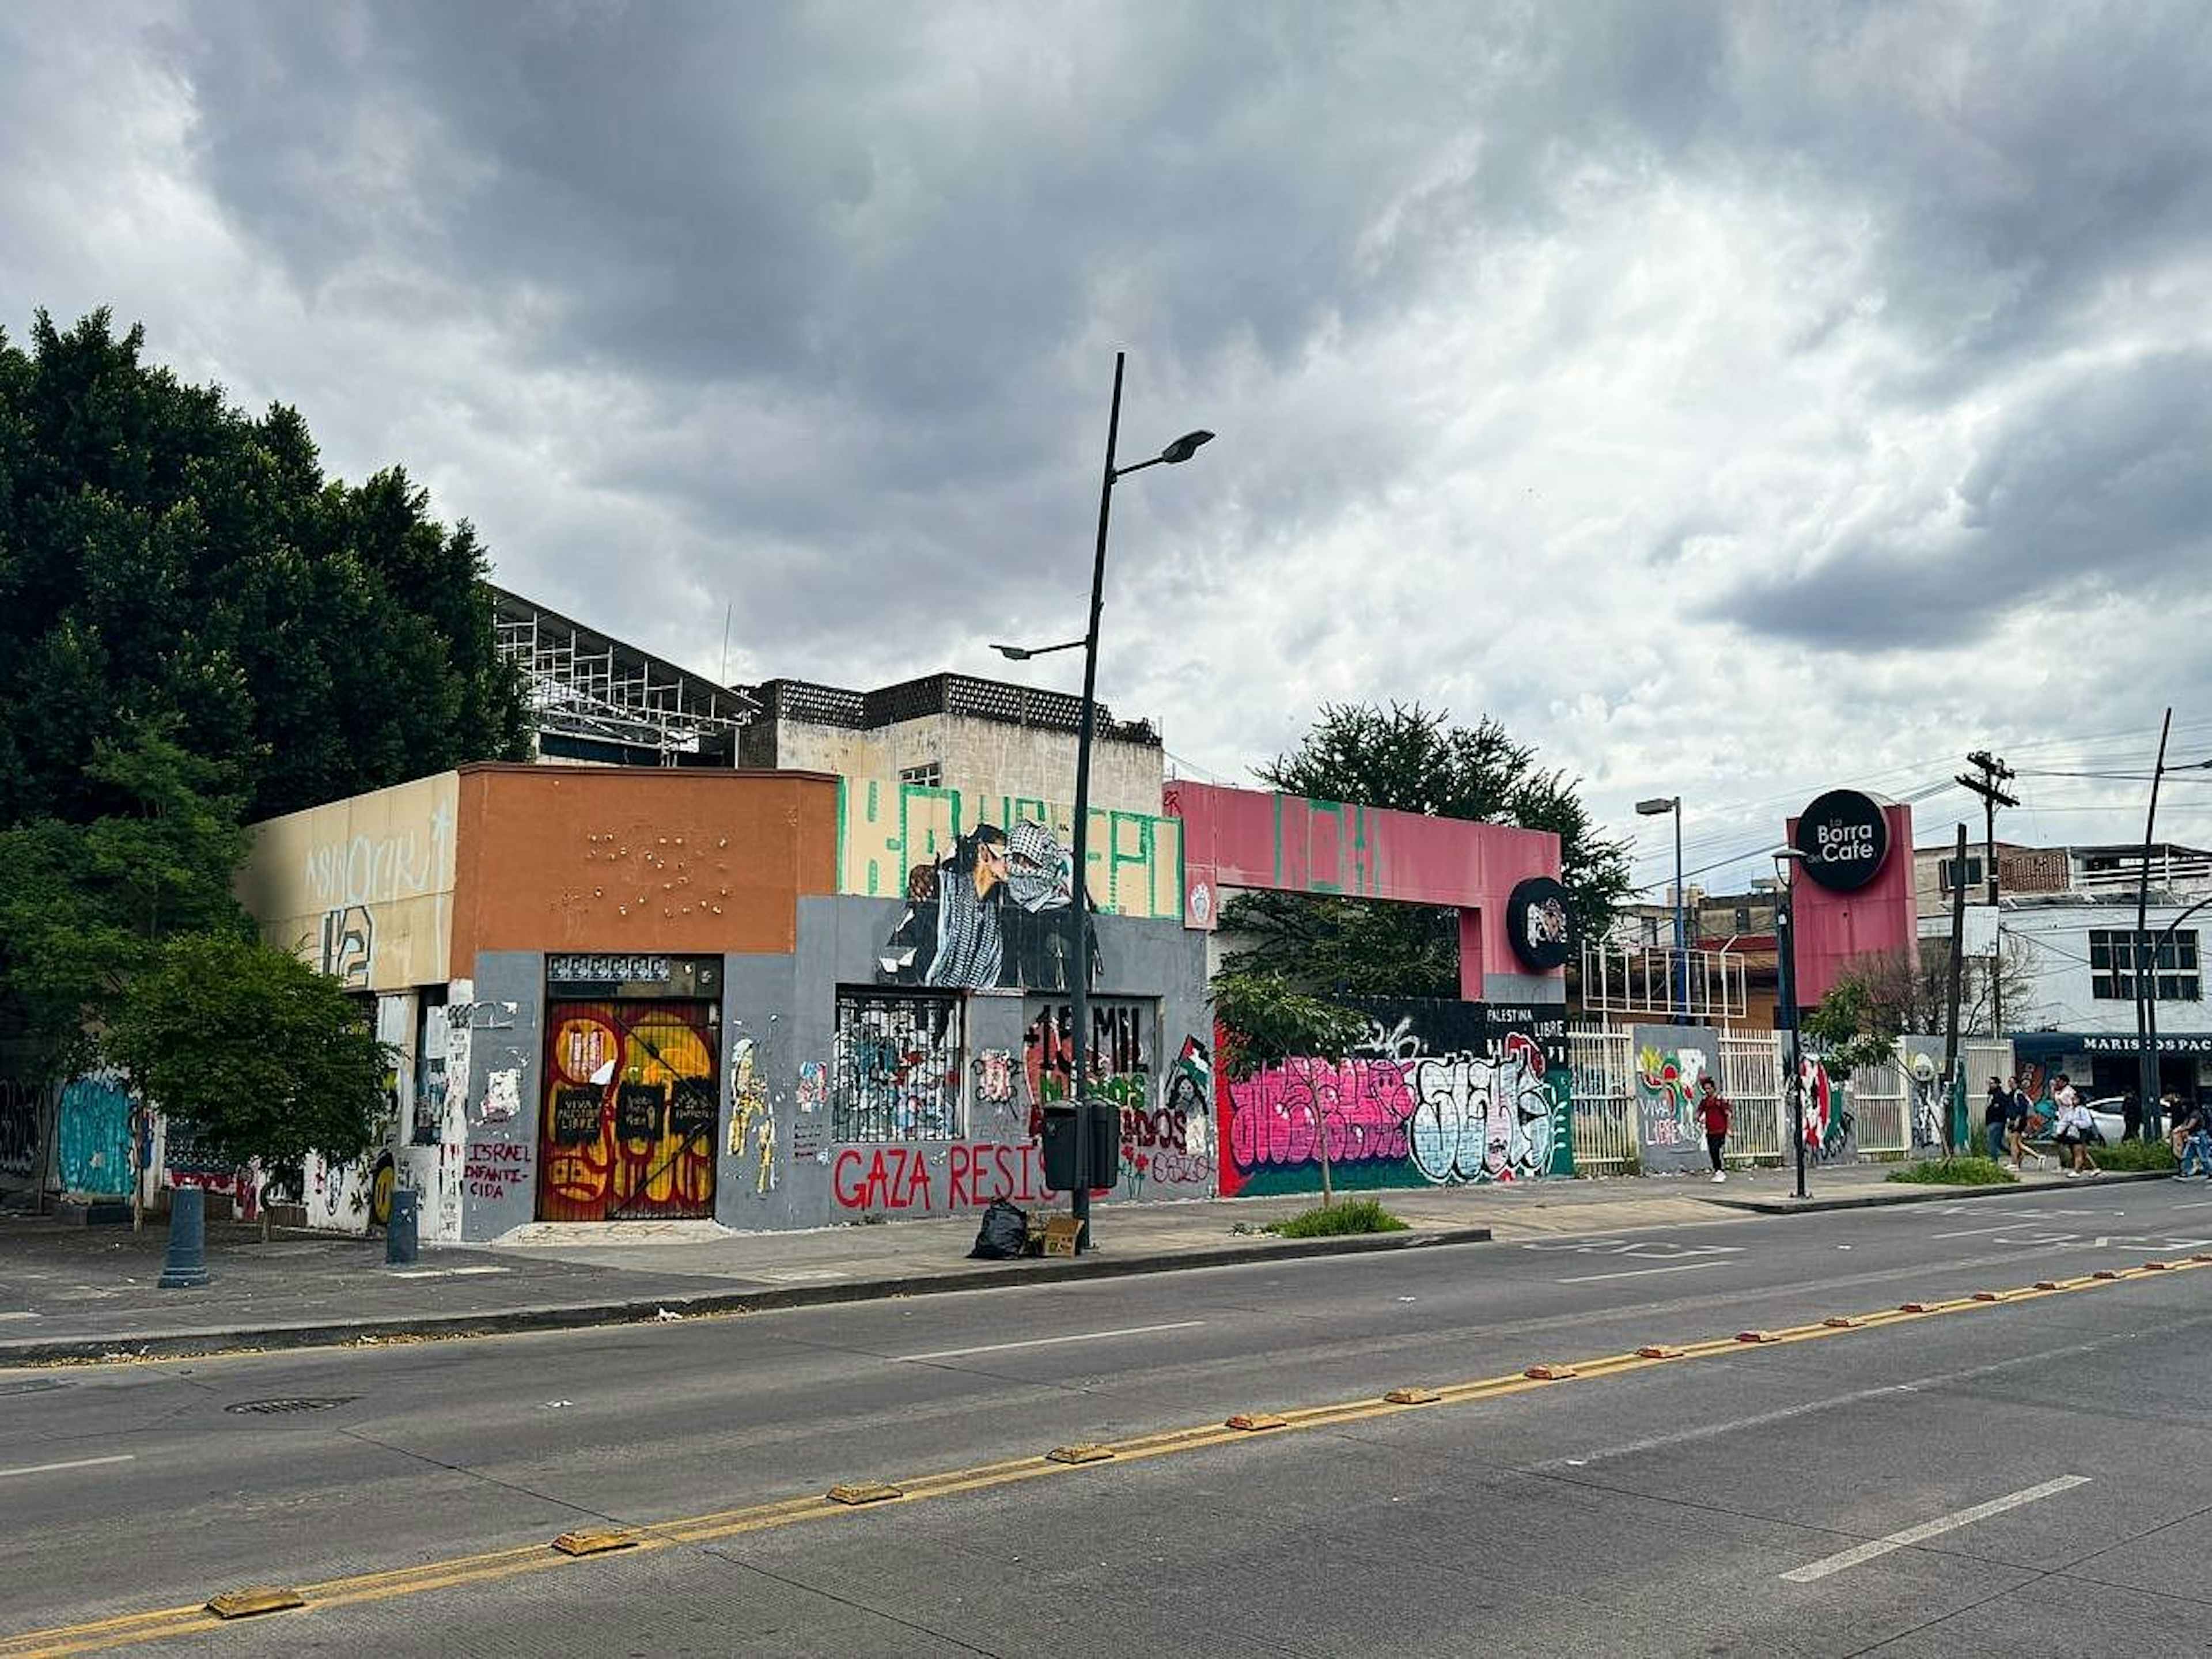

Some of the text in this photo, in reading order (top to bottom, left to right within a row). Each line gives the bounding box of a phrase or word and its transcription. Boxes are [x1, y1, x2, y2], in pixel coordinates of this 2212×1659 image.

[1817, 824, 1873, 844] Borra
[1822, 840, 1874, 862] Cafe
[1487, 1009, 1533, 1022] PALESTINA
[1533, 1020, 1565, 1037] LIBRE
[1093, 1006, 1148, 1074] MIL
[2084, 1037, 2176, 1051] MARISOS
[468, 1142, 532, 1162] ISRAEL
[835, 1148, 930, 1210] GAZA
[469, 1181, 503, 1199] CIDA
